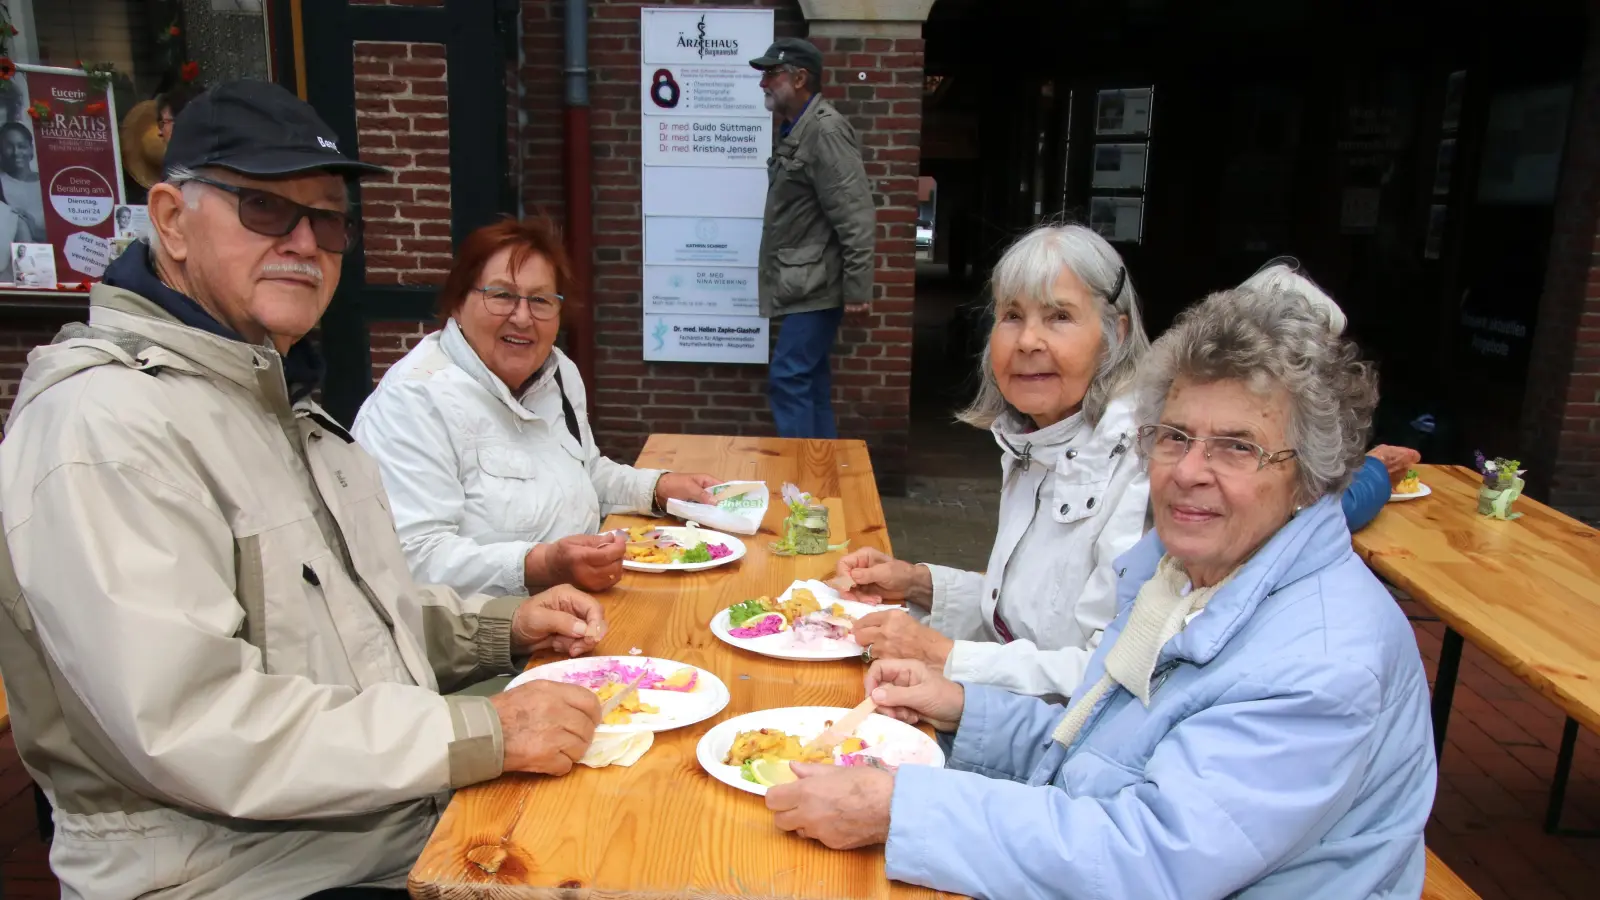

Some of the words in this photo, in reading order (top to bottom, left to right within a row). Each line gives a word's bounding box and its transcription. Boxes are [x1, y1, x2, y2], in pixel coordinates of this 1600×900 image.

[50, 113, 106, 132] RATIS
[692, 123, 717, 132] Guido
[720, 123, 762, 132] Süttmann
[41, 127, 108, 140] HAUTANALYSE
[693, 134, 712, 142] Lars
[714, 134, 756, 143] Makowski
[693, 144, 725, 153] Kristina
[726, 145, 758, 154] Jensen
[70, 177, 91, 185] Deine
[56, 185, 90, 195] Beratung
[77, 234, 94, 244] Jetzt
[82, 245, 105, 258] Termin
